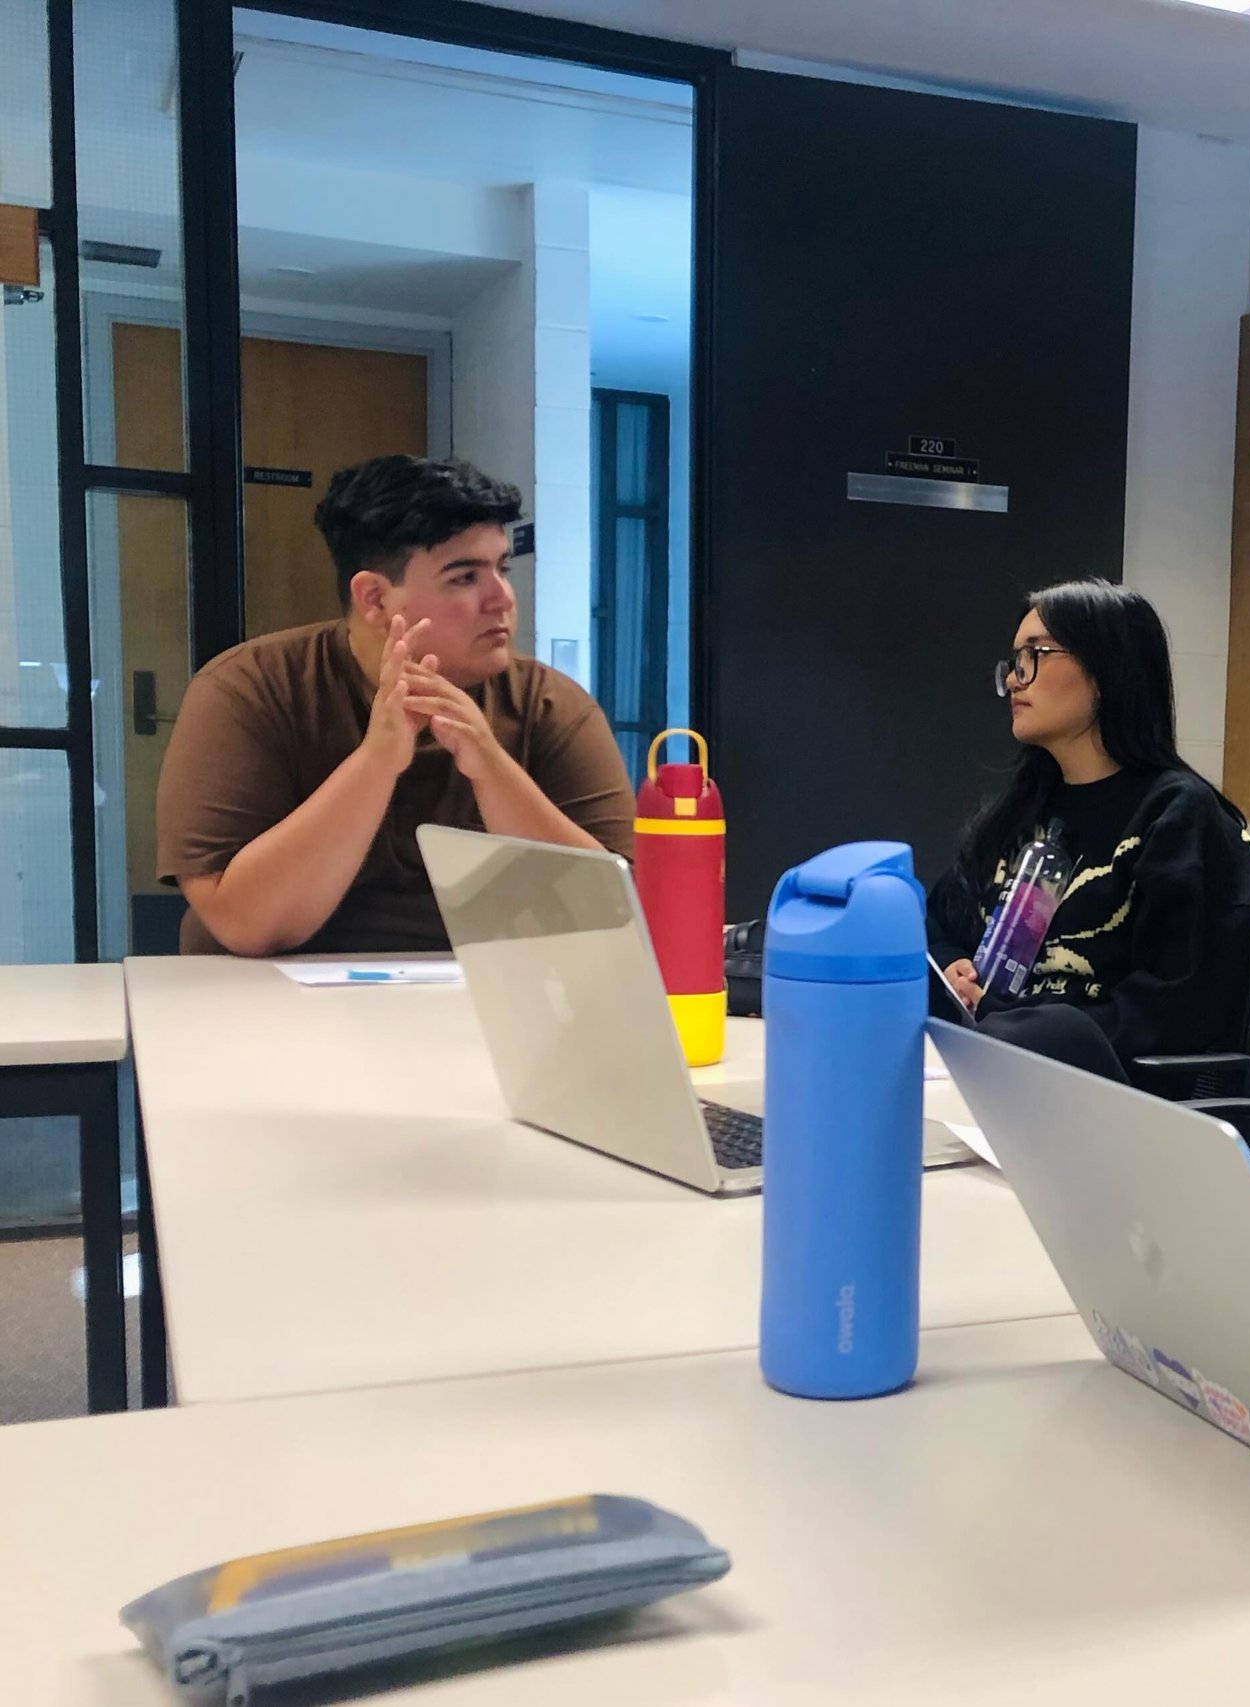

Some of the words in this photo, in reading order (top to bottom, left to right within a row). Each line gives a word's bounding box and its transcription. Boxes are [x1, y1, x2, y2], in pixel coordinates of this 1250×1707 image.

[920, 439, 944, 454] 220
[895, 460, 929, 472] FREEMAN
[933, 463, 964, 475] SEMINAR
[253, 471, 299, 483] RESTROOM
